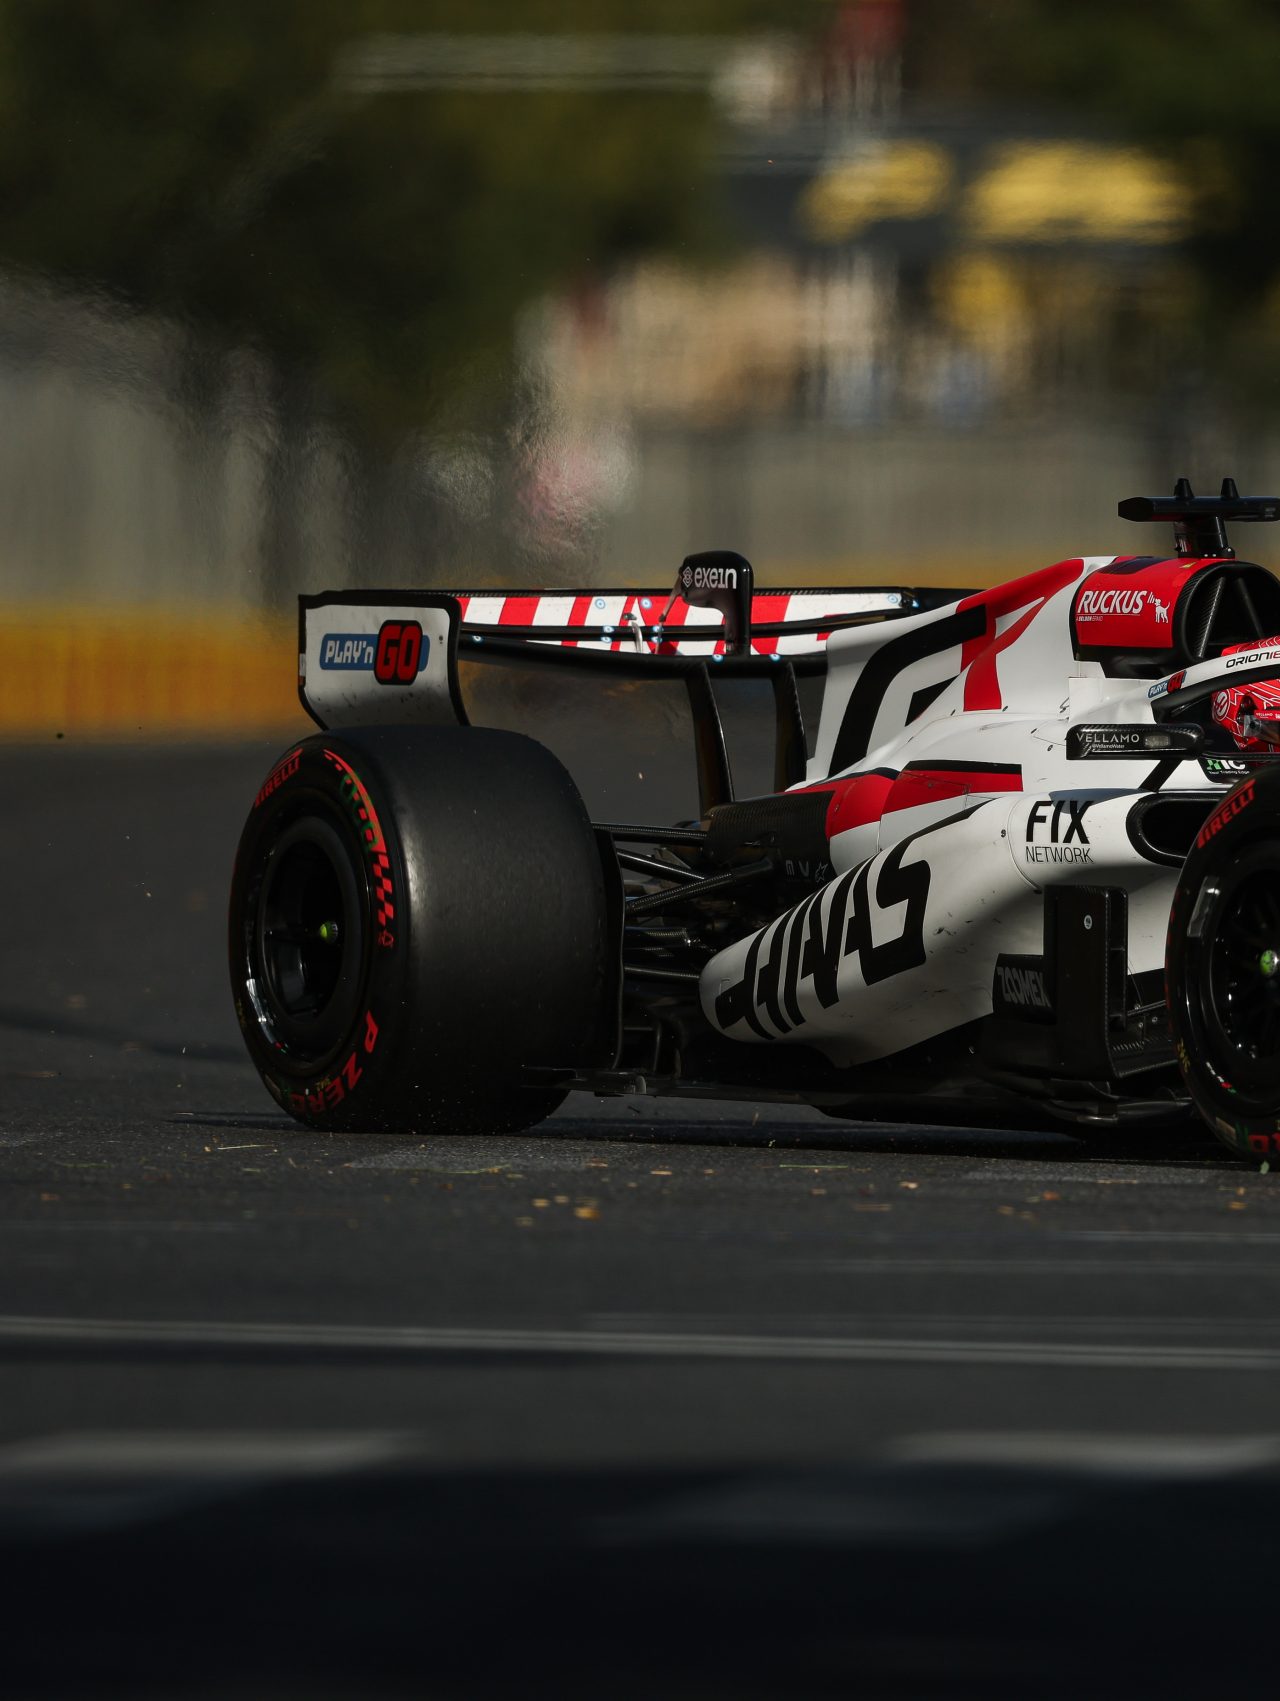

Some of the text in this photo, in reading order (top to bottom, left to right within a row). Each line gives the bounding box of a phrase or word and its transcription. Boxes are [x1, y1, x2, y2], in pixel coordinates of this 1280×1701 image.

[1078, 590, 1147, 614] RUCKUS
[378, 623, 420, 681] GO
[1076, 733, 1140, 743] VELLAMO
[1026, 800, 1093, 844] FIX
[1196, 779, 1256, 848] PIRELLI
[1026, 846, 1093, 863] NETWORK
[994, 966, 1052, 1008] ZOOMEX
